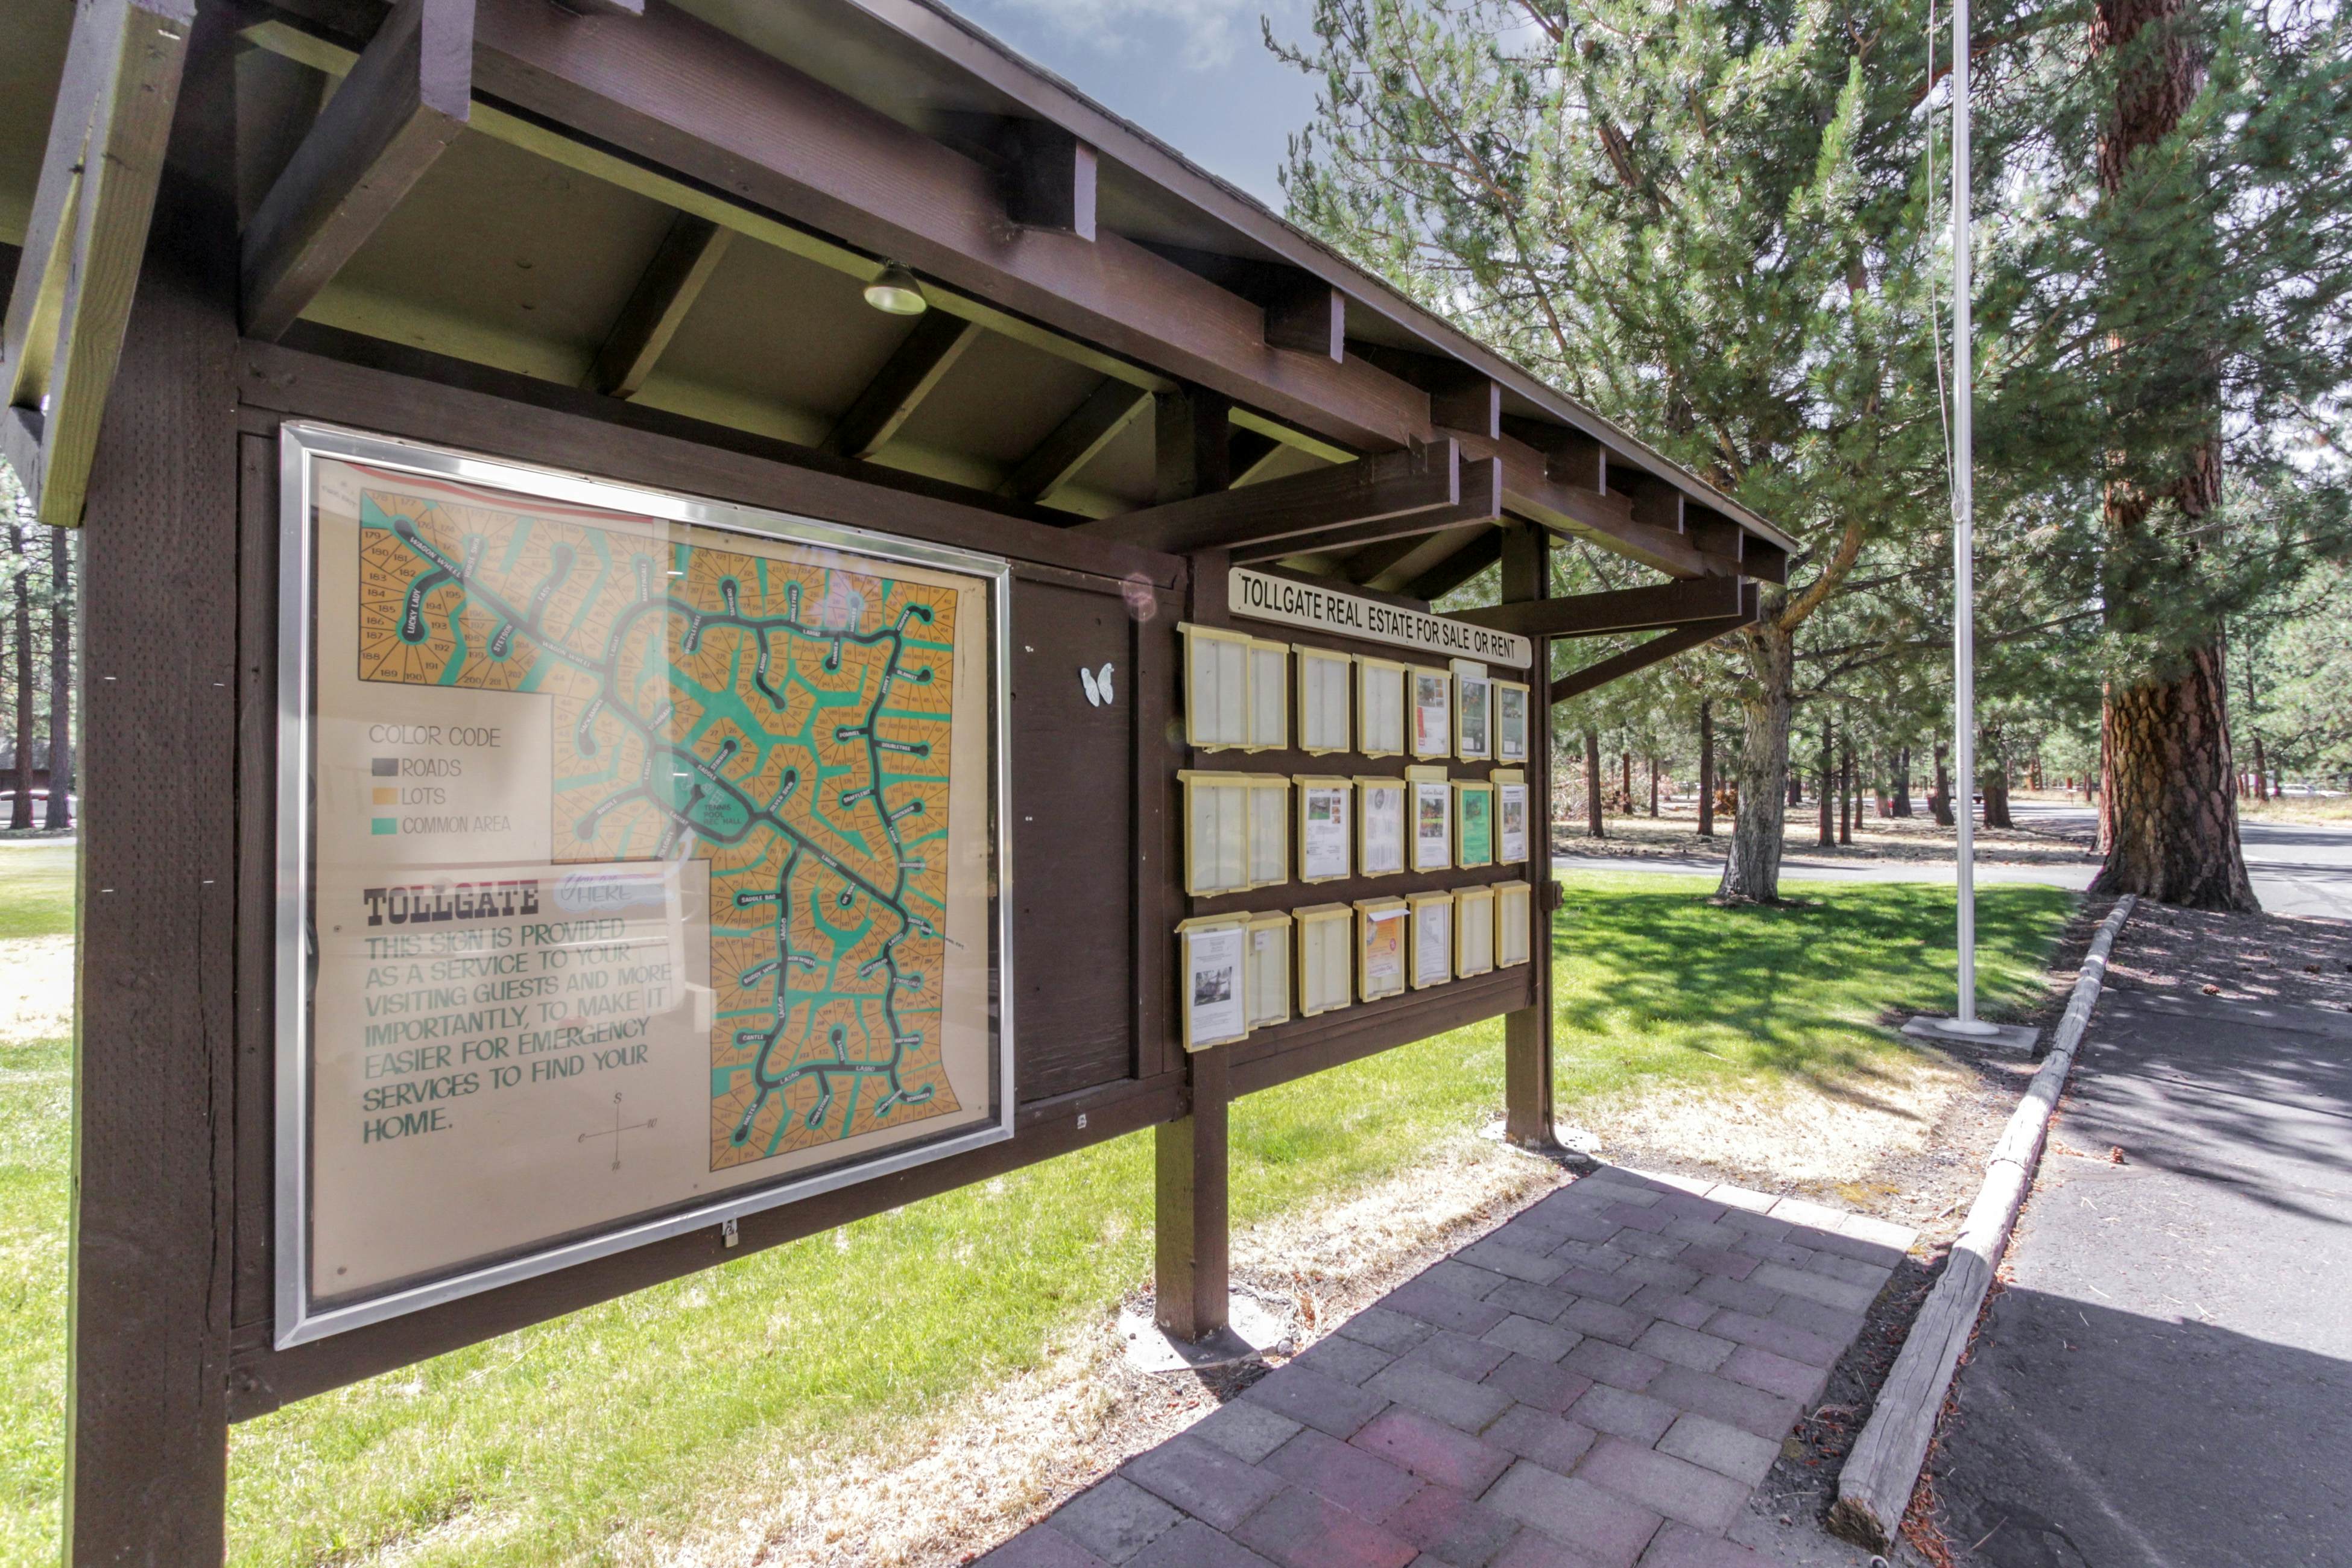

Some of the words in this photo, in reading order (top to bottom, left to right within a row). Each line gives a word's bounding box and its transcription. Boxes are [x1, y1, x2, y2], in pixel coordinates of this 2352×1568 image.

[394, 554, 407, 562] 181
[410, 537, 437, 558] WAGON
[437, 557, 461, 577] WHEEL
[370, 573, 387, 581] 183
[400, 569, 416, 577] 182
[411, 589, 421, 607] LADY
[407, 609, 418, 633] LUCKY
[1242, 576, 1322, 619] TOLLGATE
[1327, 596, 1362, 628] REAL
[1369, 606, 1413, 639] ESTATE
[1417, 618, 1440, 645] FOR
[1443, 624, 1469, 650] SALE
[1475, 631, 1488, 654] OR
[1491, 635, 1515, 659] RENT
[493, 624, 513, 652] STETSON
[882, 675, 890, 694] LARIAT
[897, 669, 917, 680] BLANKET
[369, 724, 443, 745] COLOR
[449, 727, 501, 747] CODE
[402, 758, 462, 777] ROADS
[710, 749, 729, 771] STIRRUP
[697, 765, 717, 781] SADDLE
[402, 788, 446, 805] LOTS
[782, 782, 794, 795] SPUR
[402, 817, 468, 834] COMMON
[473, 815, 511, 832] AREA
[669, 811, 689, 826] LARIAT
[821, 855, 838, 868] LARIAT
[364, 879, 539, 926] TOLLGATE
[578, 885, 632, 903] HERE
[741, 894, 762, 903] SADDLE
[365, 934, 421, 959] THIS
[430, 929, 482, 955] SIGN
[492, 927, 512, 949] IS
[521, 918, 625, 947] PROVIDED
[365, 966, 399, 989] AS
[407, 963, 424, 984] A
[431, 952, 528, 981] SERVICE
[538, 950, 567, 970] TO
[577, 943, 630, 966] YOUR
[744, 972, 761, 984] BUGGY
[763, 963, 777, 974] WHIP
[365, 987, 466, 1017] VISITING
[473, 975, 559, 1004] GUESTS
[566, 970, 609, 992] AND
[618, 964, 672, 986] MORE
[365, 1005, 529, 1048] IMPORTANTLY,
[537, 1001, 567, 1023] TO
[578, 990, 639, 1017] MAKE
[648, 987, 667, 1008] IT
[365, 1045, 451, 1080] EASIER
[462, 1037, 510, 1064] FOR
[519, 1016, 650, 1055] EMERGENCY
[363, 1072, 479, 1111] SERVICES
[489, 1065, 521, 1089] TO
[532, 1055, 584, 1083] FIND
[592, 1044, 648, 1070] YOUR
[780, 1071, 800, 1085] LASSO
[906, 1093, 929, 1102] SCHOONER
[743, 1104, 757, 1125] HALTER
[811, 1095, 830, 1125] CONESTOGA
[364, 1107, 453, 1143] HOME.
